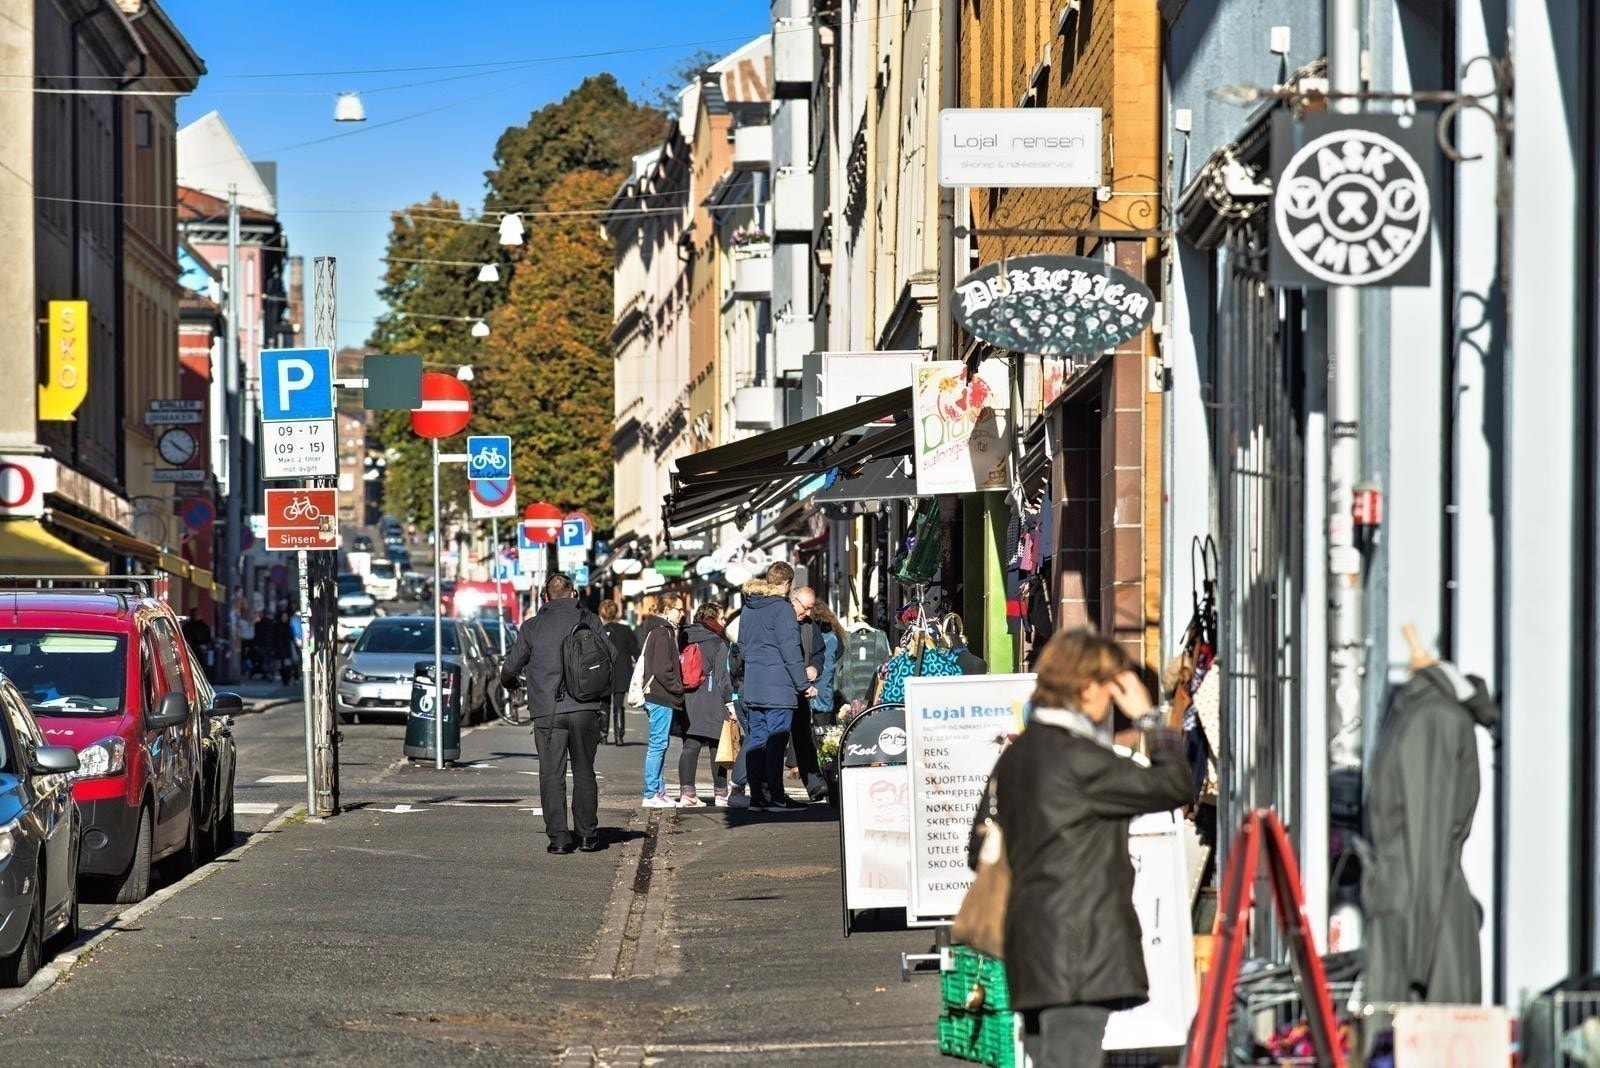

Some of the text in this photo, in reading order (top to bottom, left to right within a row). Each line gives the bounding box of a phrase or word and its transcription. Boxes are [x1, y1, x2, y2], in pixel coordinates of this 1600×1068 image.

[953, 133, 1085, 150] Lojal renseri
[1317, 139, 1395, 182] ASK
[60, 307, 77, 389] SKO
[278, 359, 314, 411] P
[278, 426, 293, 436] 09
[309, 425, 319, 435] 17
[274, 443, 294, 455] (09
[309, 442, 325, 453] 15)
[280, 534, 316, 544] Sinsen
[563, 523, 579, 545] P
[922, 705, 1014, 721] Lojal Rens
[848, 744, 878, 756] Kool
[924, 748, 949, 757] RENS
[925, 762, 950, 770] VASK
[927, 845, 960, 855] UTLEIE
[928, 860, 964, 869] SKO OG
